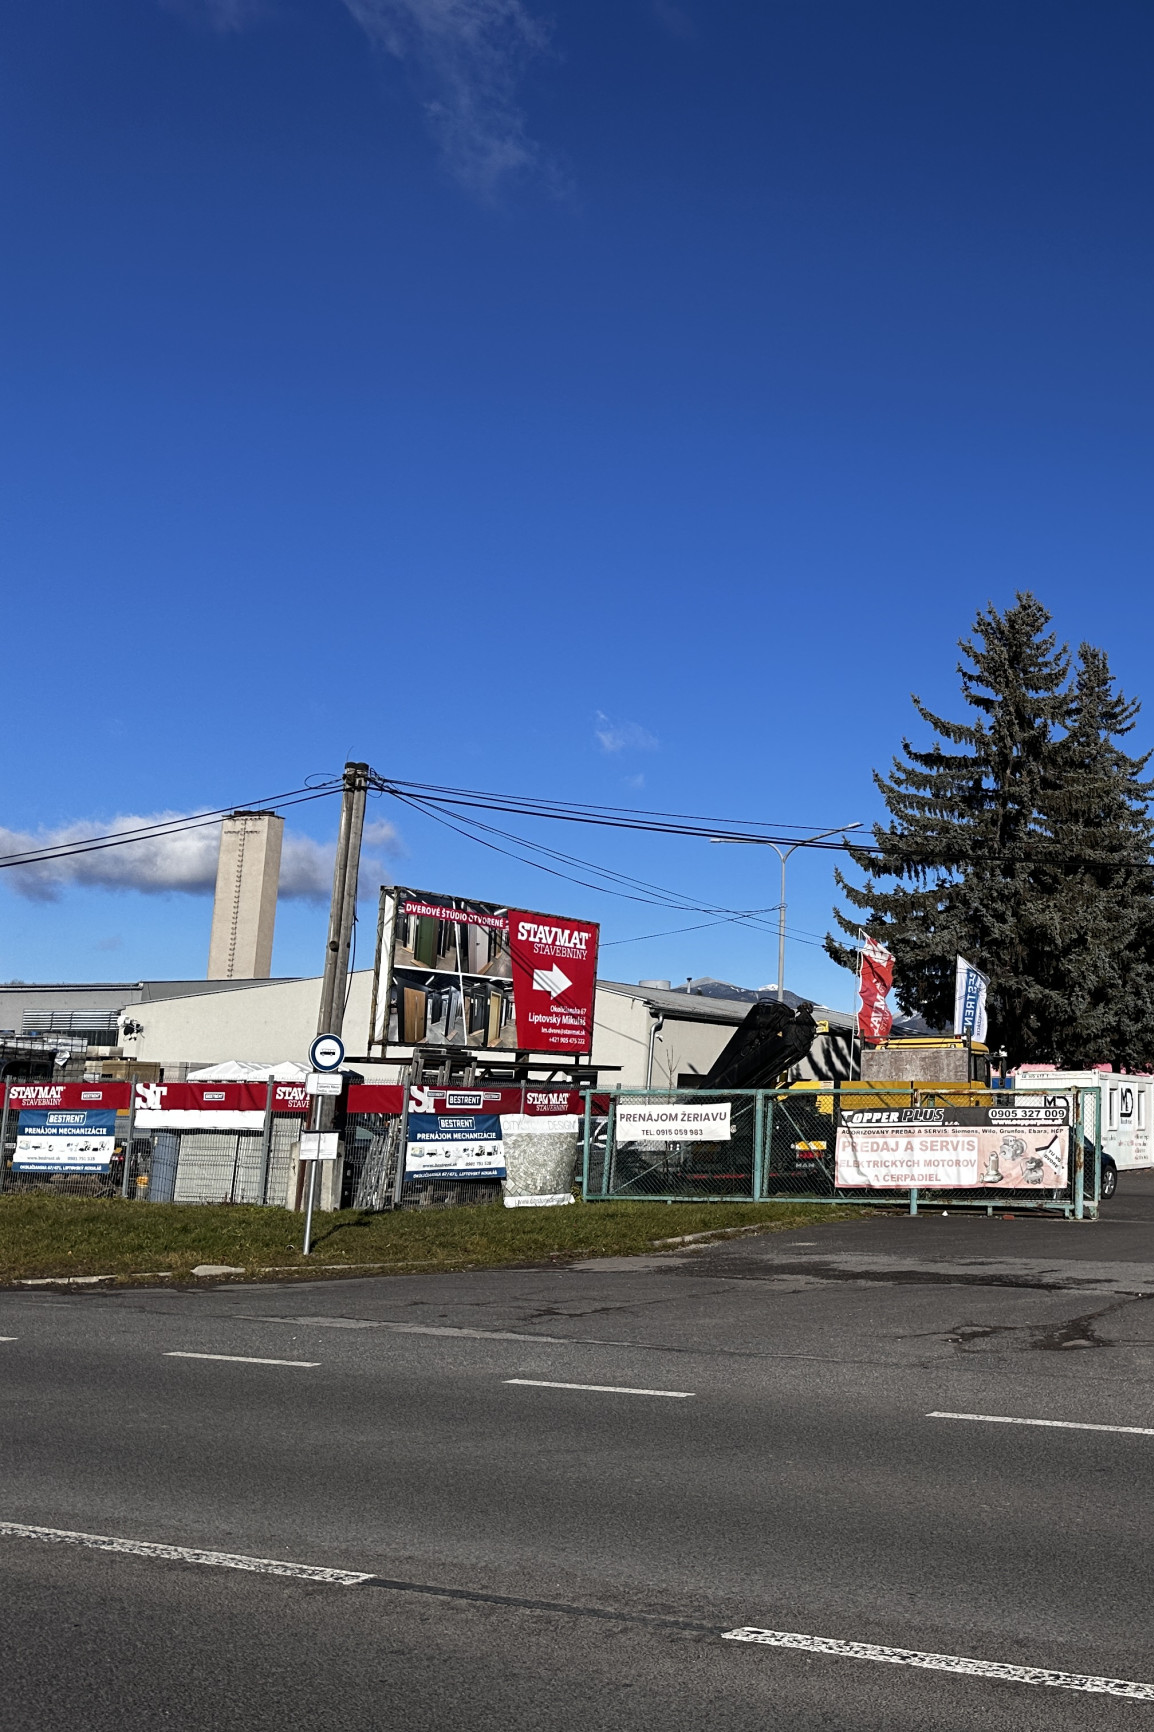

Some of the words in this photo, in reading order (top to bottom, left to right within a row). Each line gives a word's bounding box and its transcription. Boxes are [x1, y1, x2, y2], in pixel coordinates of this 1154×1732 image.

[406, 903, 440, 917] DVEROVÉ
[441, 908, 468, 922] ŠTÚDIO
[468, 914, 504, 928] OTVORENÉ
[517, 921, 590, 949] STAVMAT
[533, 943, 588, 960] STAVEBNINY
[528, 1012, 561, 1026] Liptovský
[561, 1014, 586, 1026] Mikuláš
[9, 1086, 64, 1099] STAVMAT
[21, 1098, 62, 1106] STAVEBNINY
[449, 1096, 481, 1104] BESTRENT
[526, 1092, 569, 1105] STAVMAT
[49, 1114, 85, 1123] BESTRENT
[619, 1111, 678, 1123] PRENÁJOM
[680, 1110, 728, 1122] ŽERIAVU
[902, 1108, 945, 1122] PLUS
[991, 1109, 1017, 1118] 0905
[1021, 1109, 1041, 1118] 327
[1044, 1109, 1065, 1118] 009
[440, 1119, 473, 1128] BESTRENT
[24, 1126, 58, 1135] PRENÁJOM
[58, 1126, 107, 1135] MECHANIZÁCIE
[416, 1131, 451, 1140] PRENÁJOM
[453, 1130, 497, 1139] MECHANIZÁCIE
[841, 1140, 899, 1153] PREDAJ
[903, 1140, 914, 1152] A
[919, 1139, 976, 1152] SERVIS
[923, 1159, 977, 1168] MOTOROV
[873, 1174, 880, 1182] A
